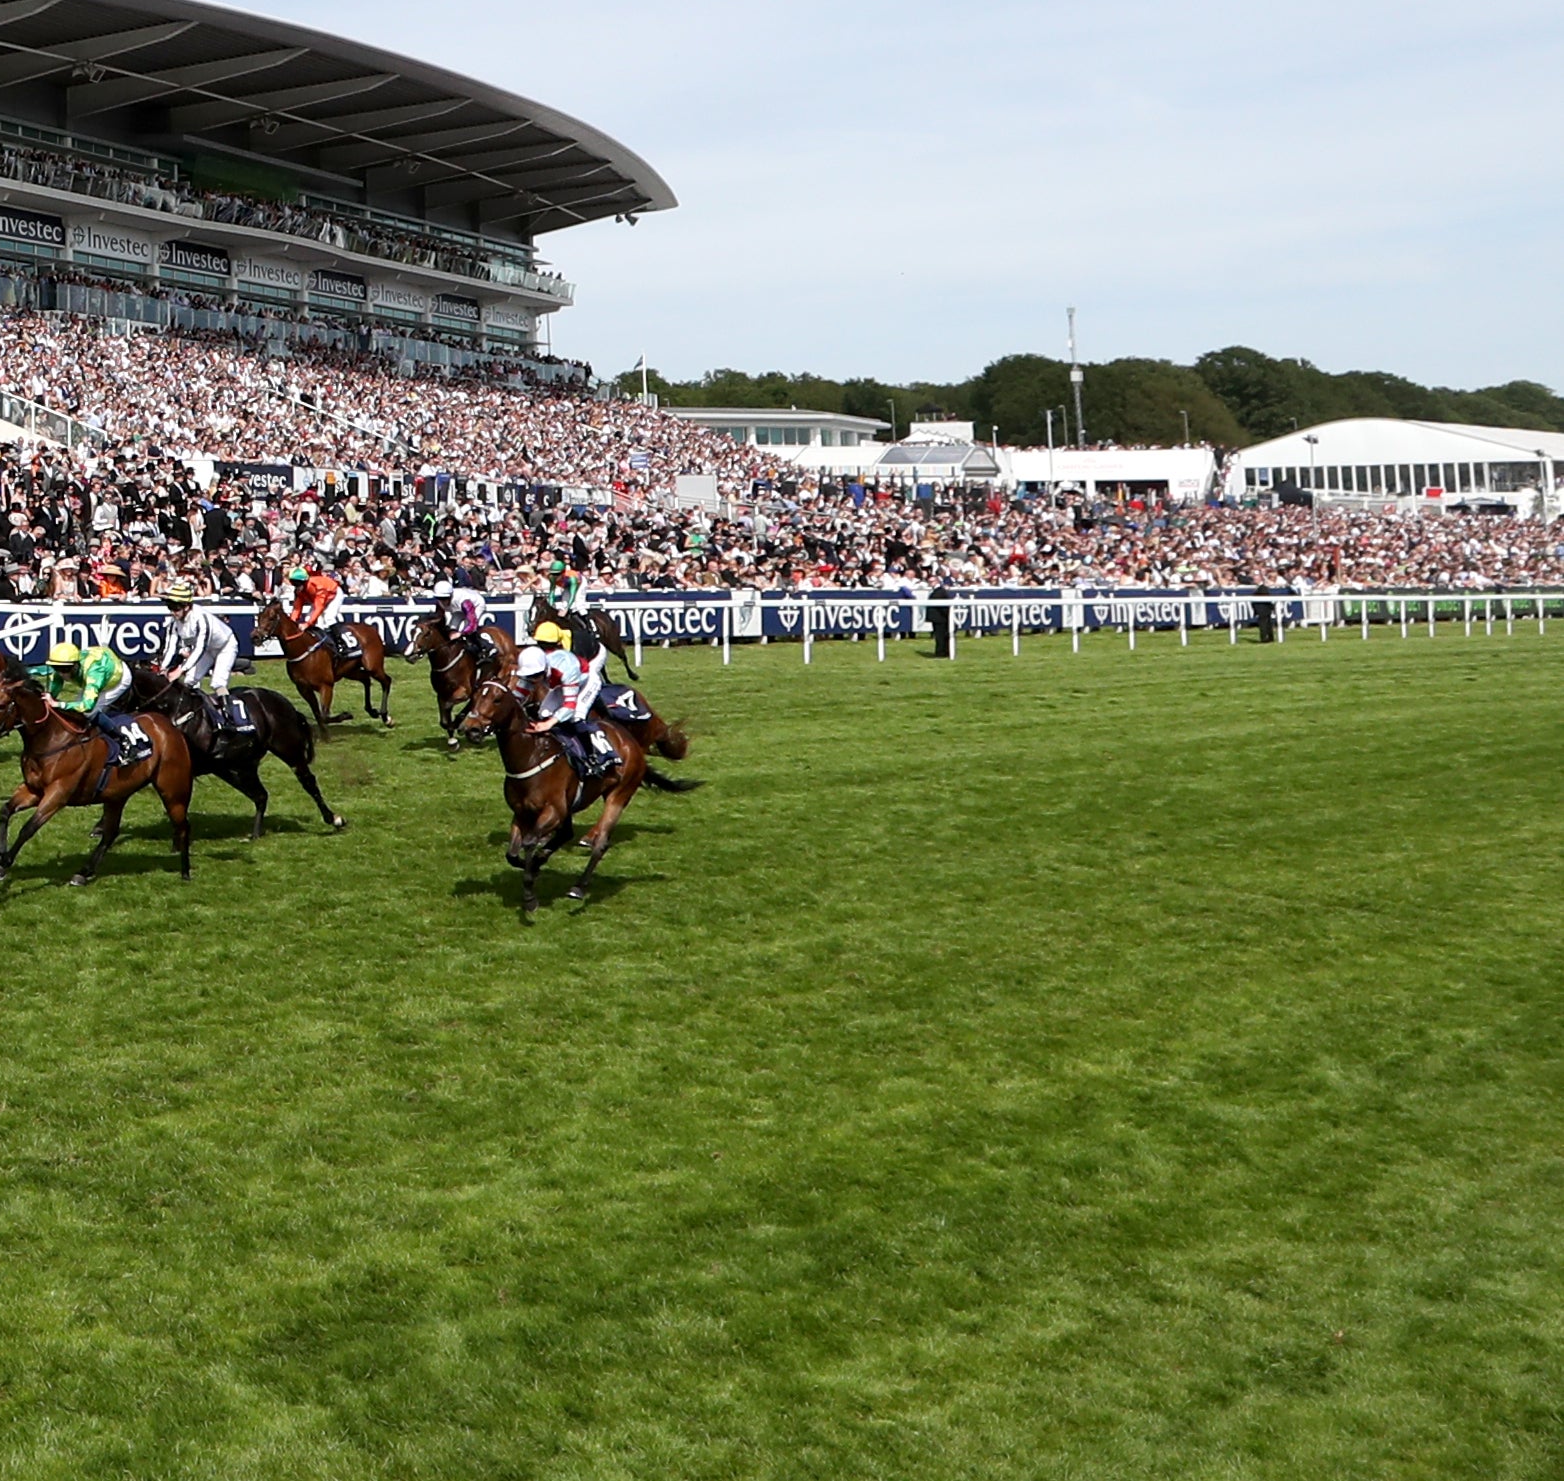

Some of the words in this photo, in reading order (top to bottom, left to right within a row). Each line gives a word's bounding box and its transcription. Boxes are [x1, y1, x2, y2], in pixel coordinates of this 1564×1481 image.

[87, 226, 149, 257] Investec
[172, 245, 228, 272] Investec
[248, 258, 300, 286] Investec
[316, 273, 365, 298] Investec
[380, 283, 425, 309] Investec
[438, 296, 479, 319] Investec
[610, 607, 717, 637] nvestec
[341, 631, 359, 648] 15
[232, 699, 247, 720] 7
[615, 690, 638, 712] 17
[120, 722, 149, 746] 14
[590, 730, 614, 755] 16
